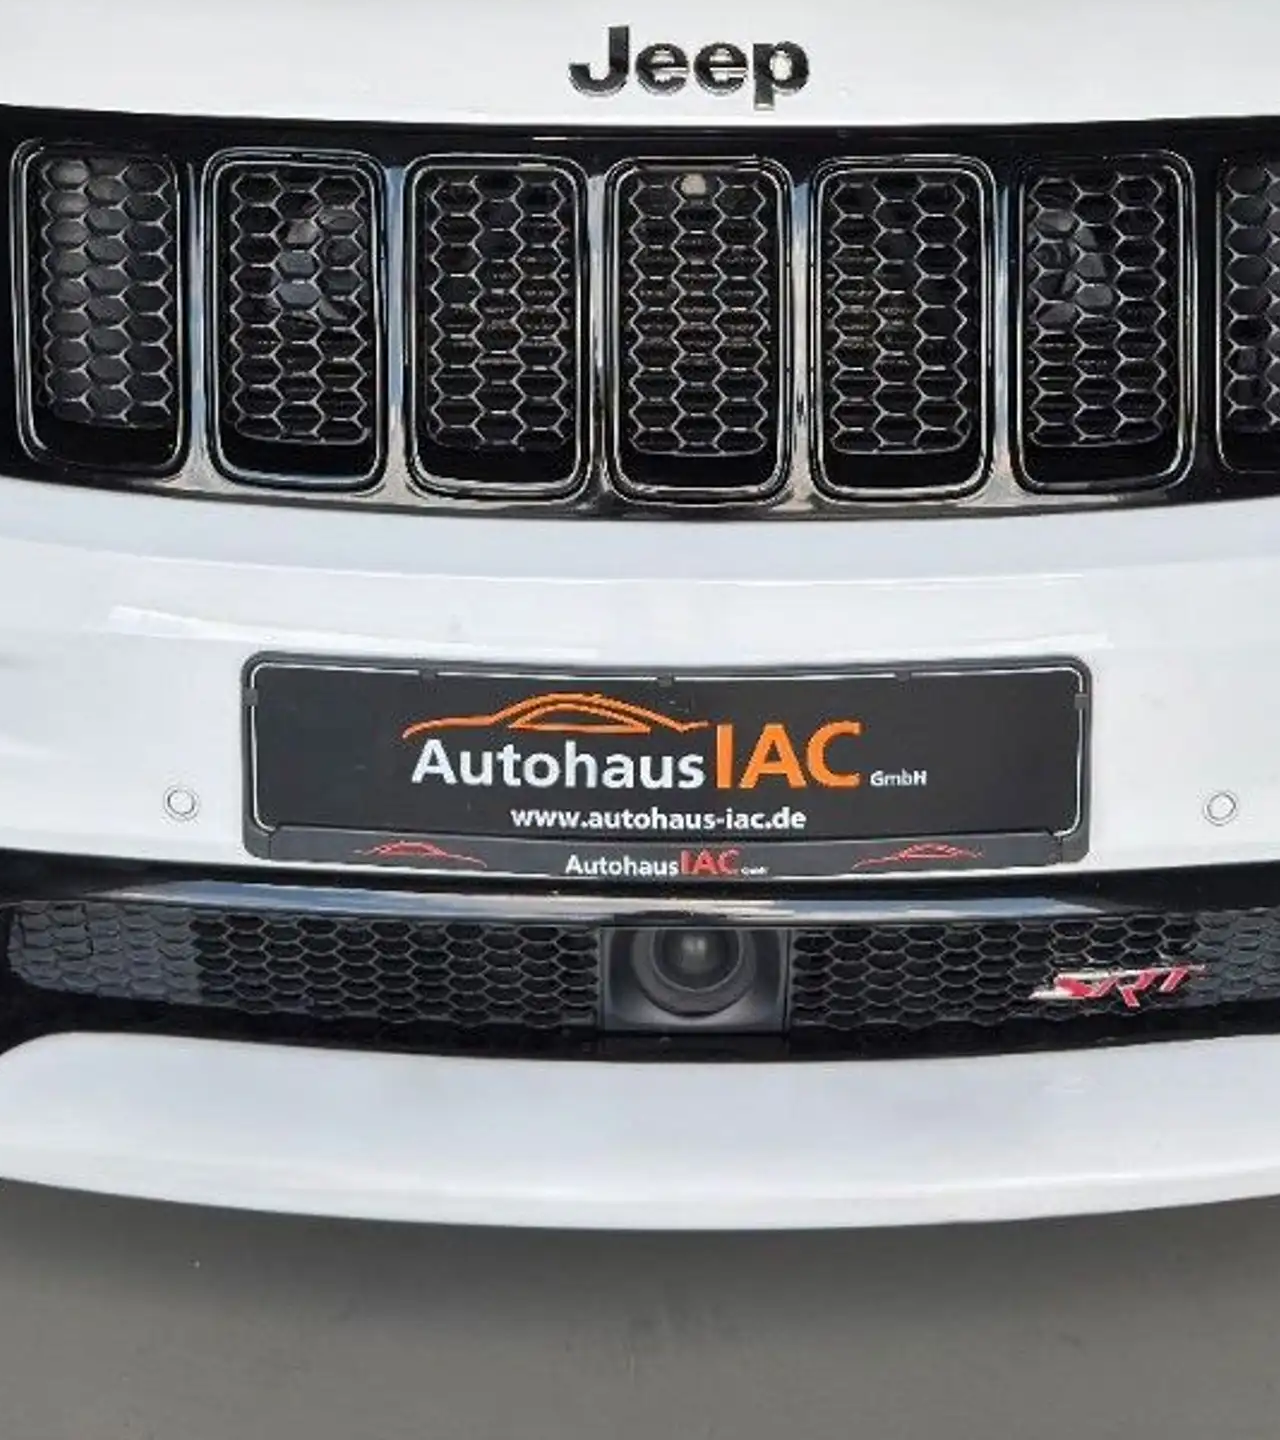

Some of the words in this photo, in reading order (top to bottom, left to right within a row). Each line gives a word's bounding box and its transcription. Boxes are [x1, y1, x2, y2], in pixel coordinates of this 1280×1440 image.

[568, 25, 810, 111] Jeep
[411, 738, 705, 789] Autohaus
[716, 720, 861, 789] IAC
[870, 769, 928, 787] GmbH
[511, 804, 807, 831] www.autohaus-iac.de
[564, 854, 679, 877] Autohaus
[680, 848, 741, 876] IAC
[1029, 964, 1204, 1009] SRT
